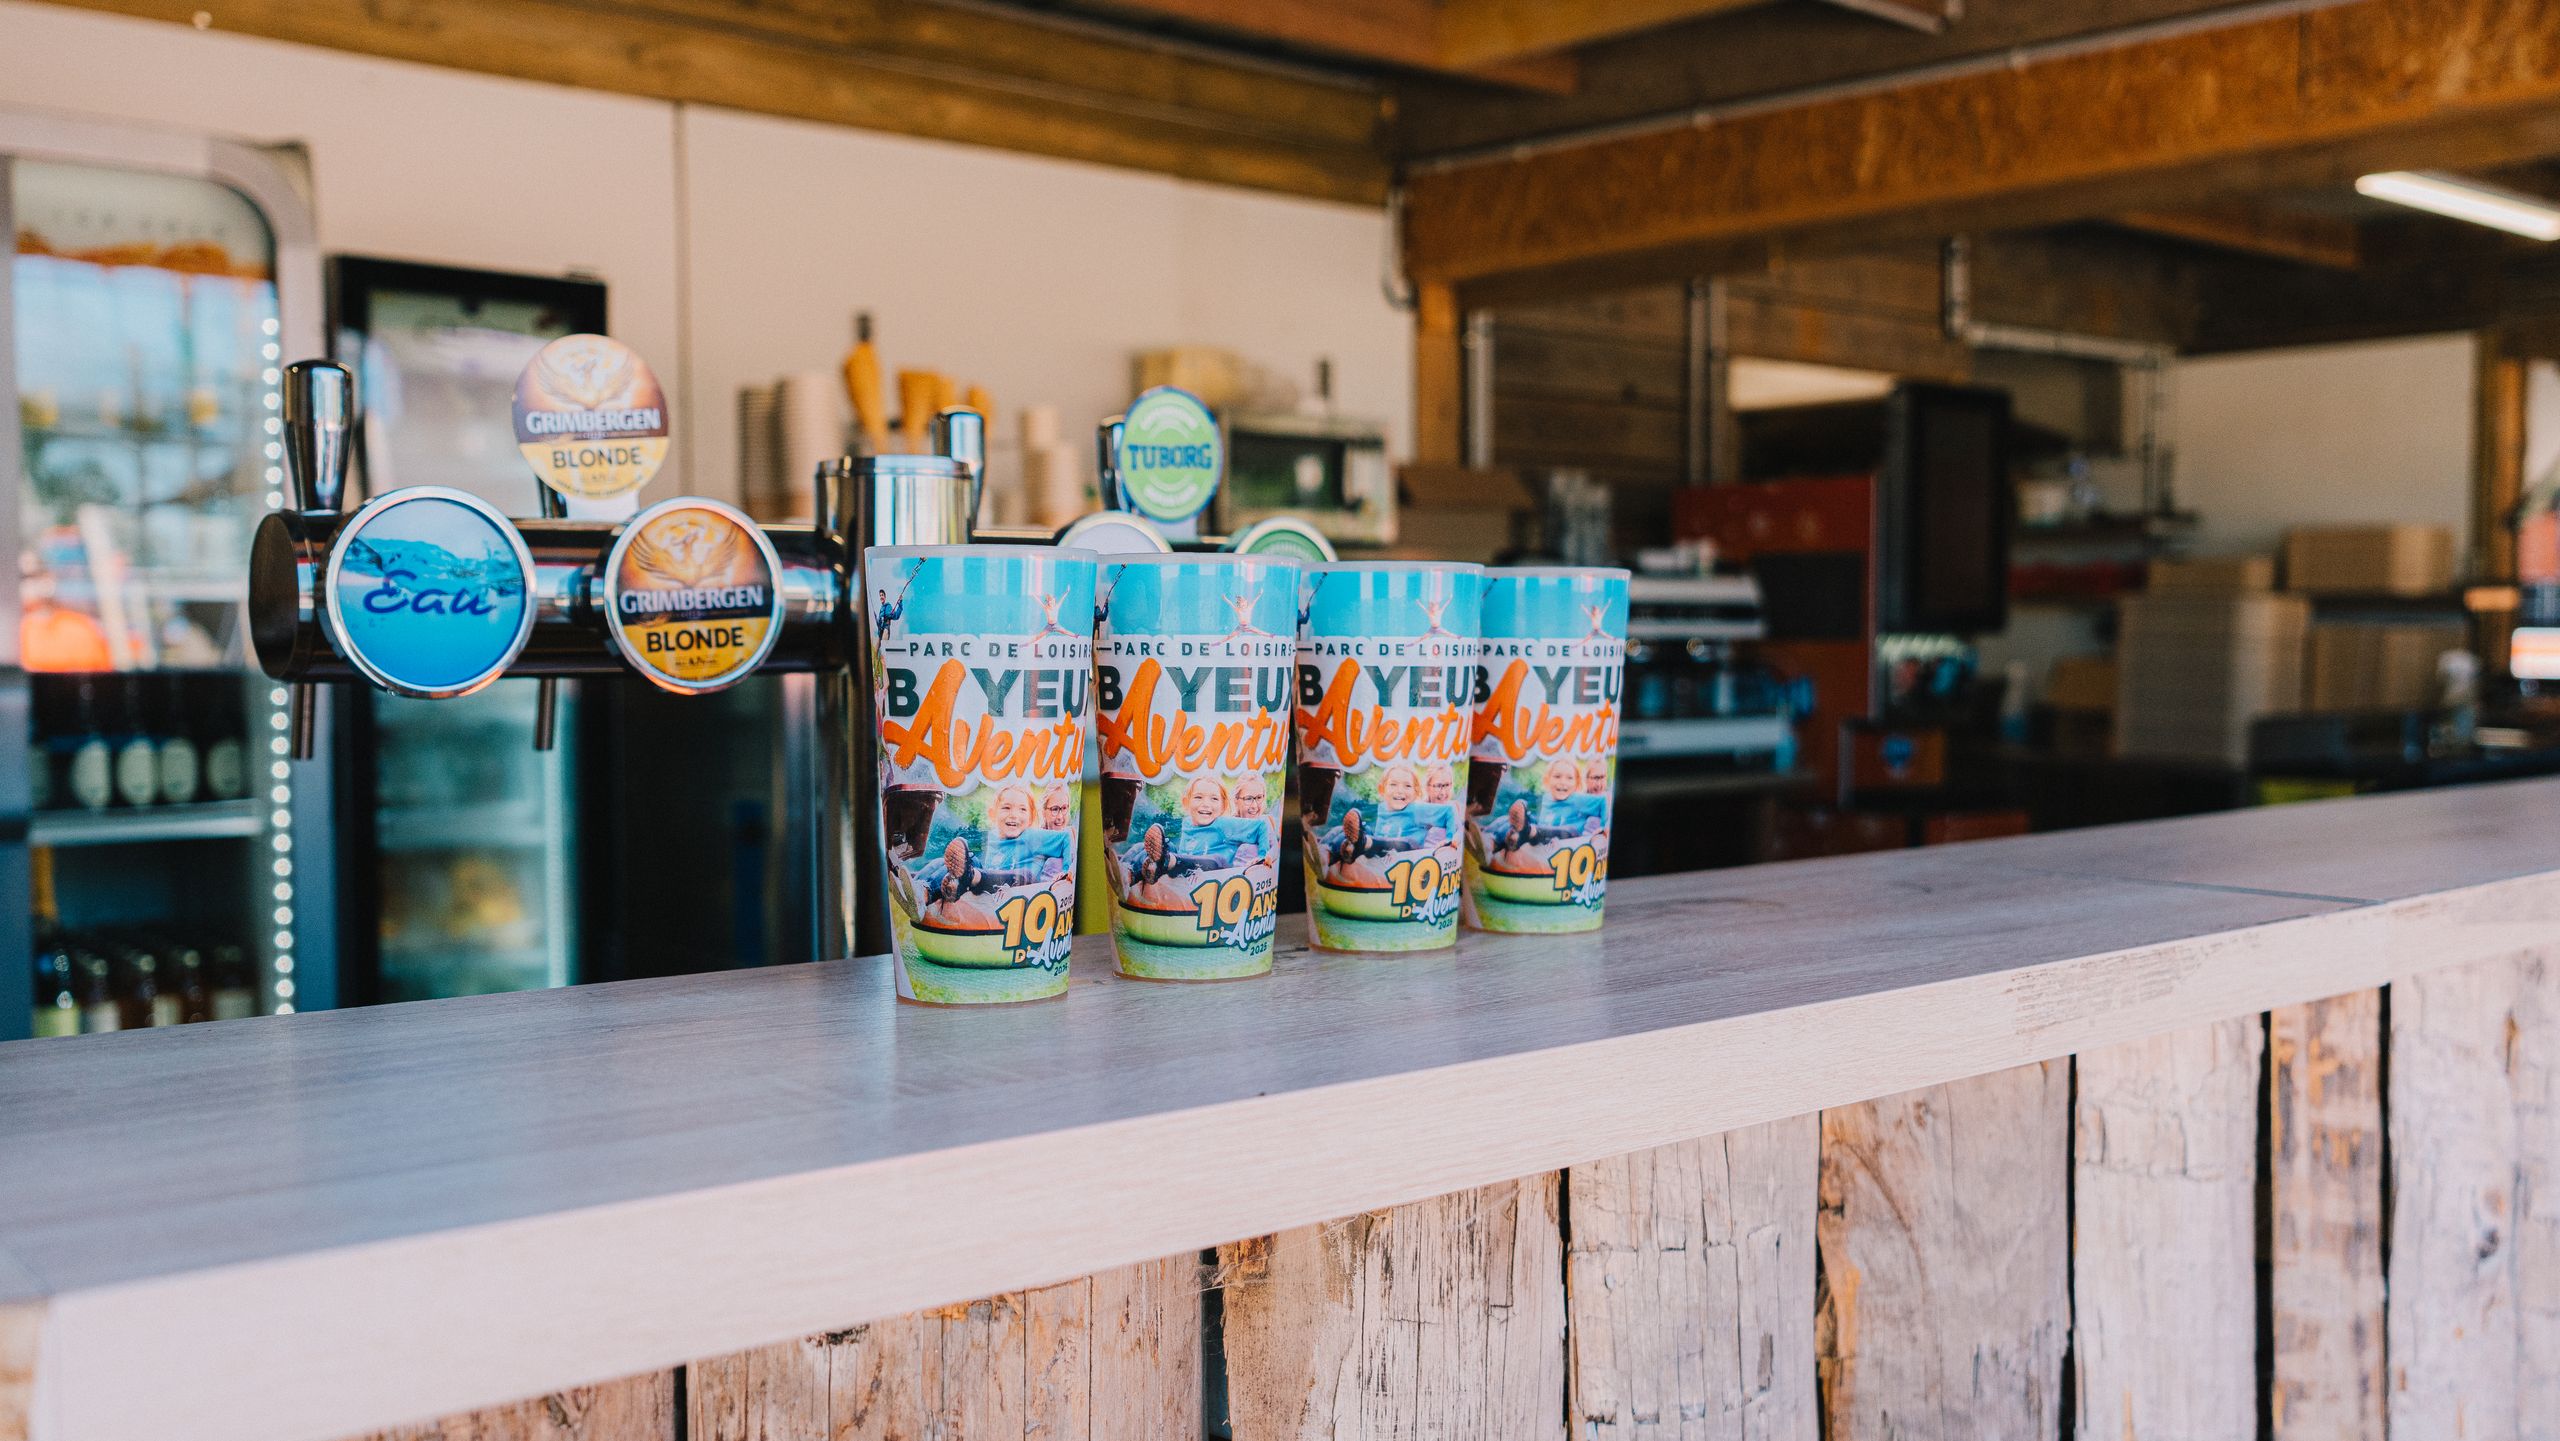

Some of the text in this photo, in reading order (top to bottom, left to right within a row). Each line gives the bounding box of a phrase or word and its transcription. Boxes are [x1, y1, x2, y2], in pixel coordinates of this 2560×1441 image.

[526, 408, 662, 434] GRIMBERGEN
[552, 447, 642, 468] BLONDE
[1128, 443, 1211, 471] TUBORG
[363, 569, 496, 615] Eau
[620, 585, 764, 614] GRIMBERGEN
[646, 627, 744, 652] BLONDE
[909, 642, 971, 656] PARC
[989, 643, 1018, 658] DE
[1114, 642, 1292, 656] PARC DE LOISIRS
[1315, 643, 1364, 656] PARC
[1379, 643, 1405, 656] DE
[1483, 644, 1532, 656] PARC
[1547, 645, 1570, 657] DE
[883, 658, 1085, 788] Aventu
[1097, 657, 1290, 778] Aventu
[1297, 657, 1472, 767] Aventu
[1388, 858, 1440, 904] 10
[1551, 845, 1596, 889] 10
[1256, 878, 1272, 891] 2015
[1193, 877, 1251, 928] 10
[999, 893, 1056, 948] 10
[1250, 942, 1268, 956] 2025
